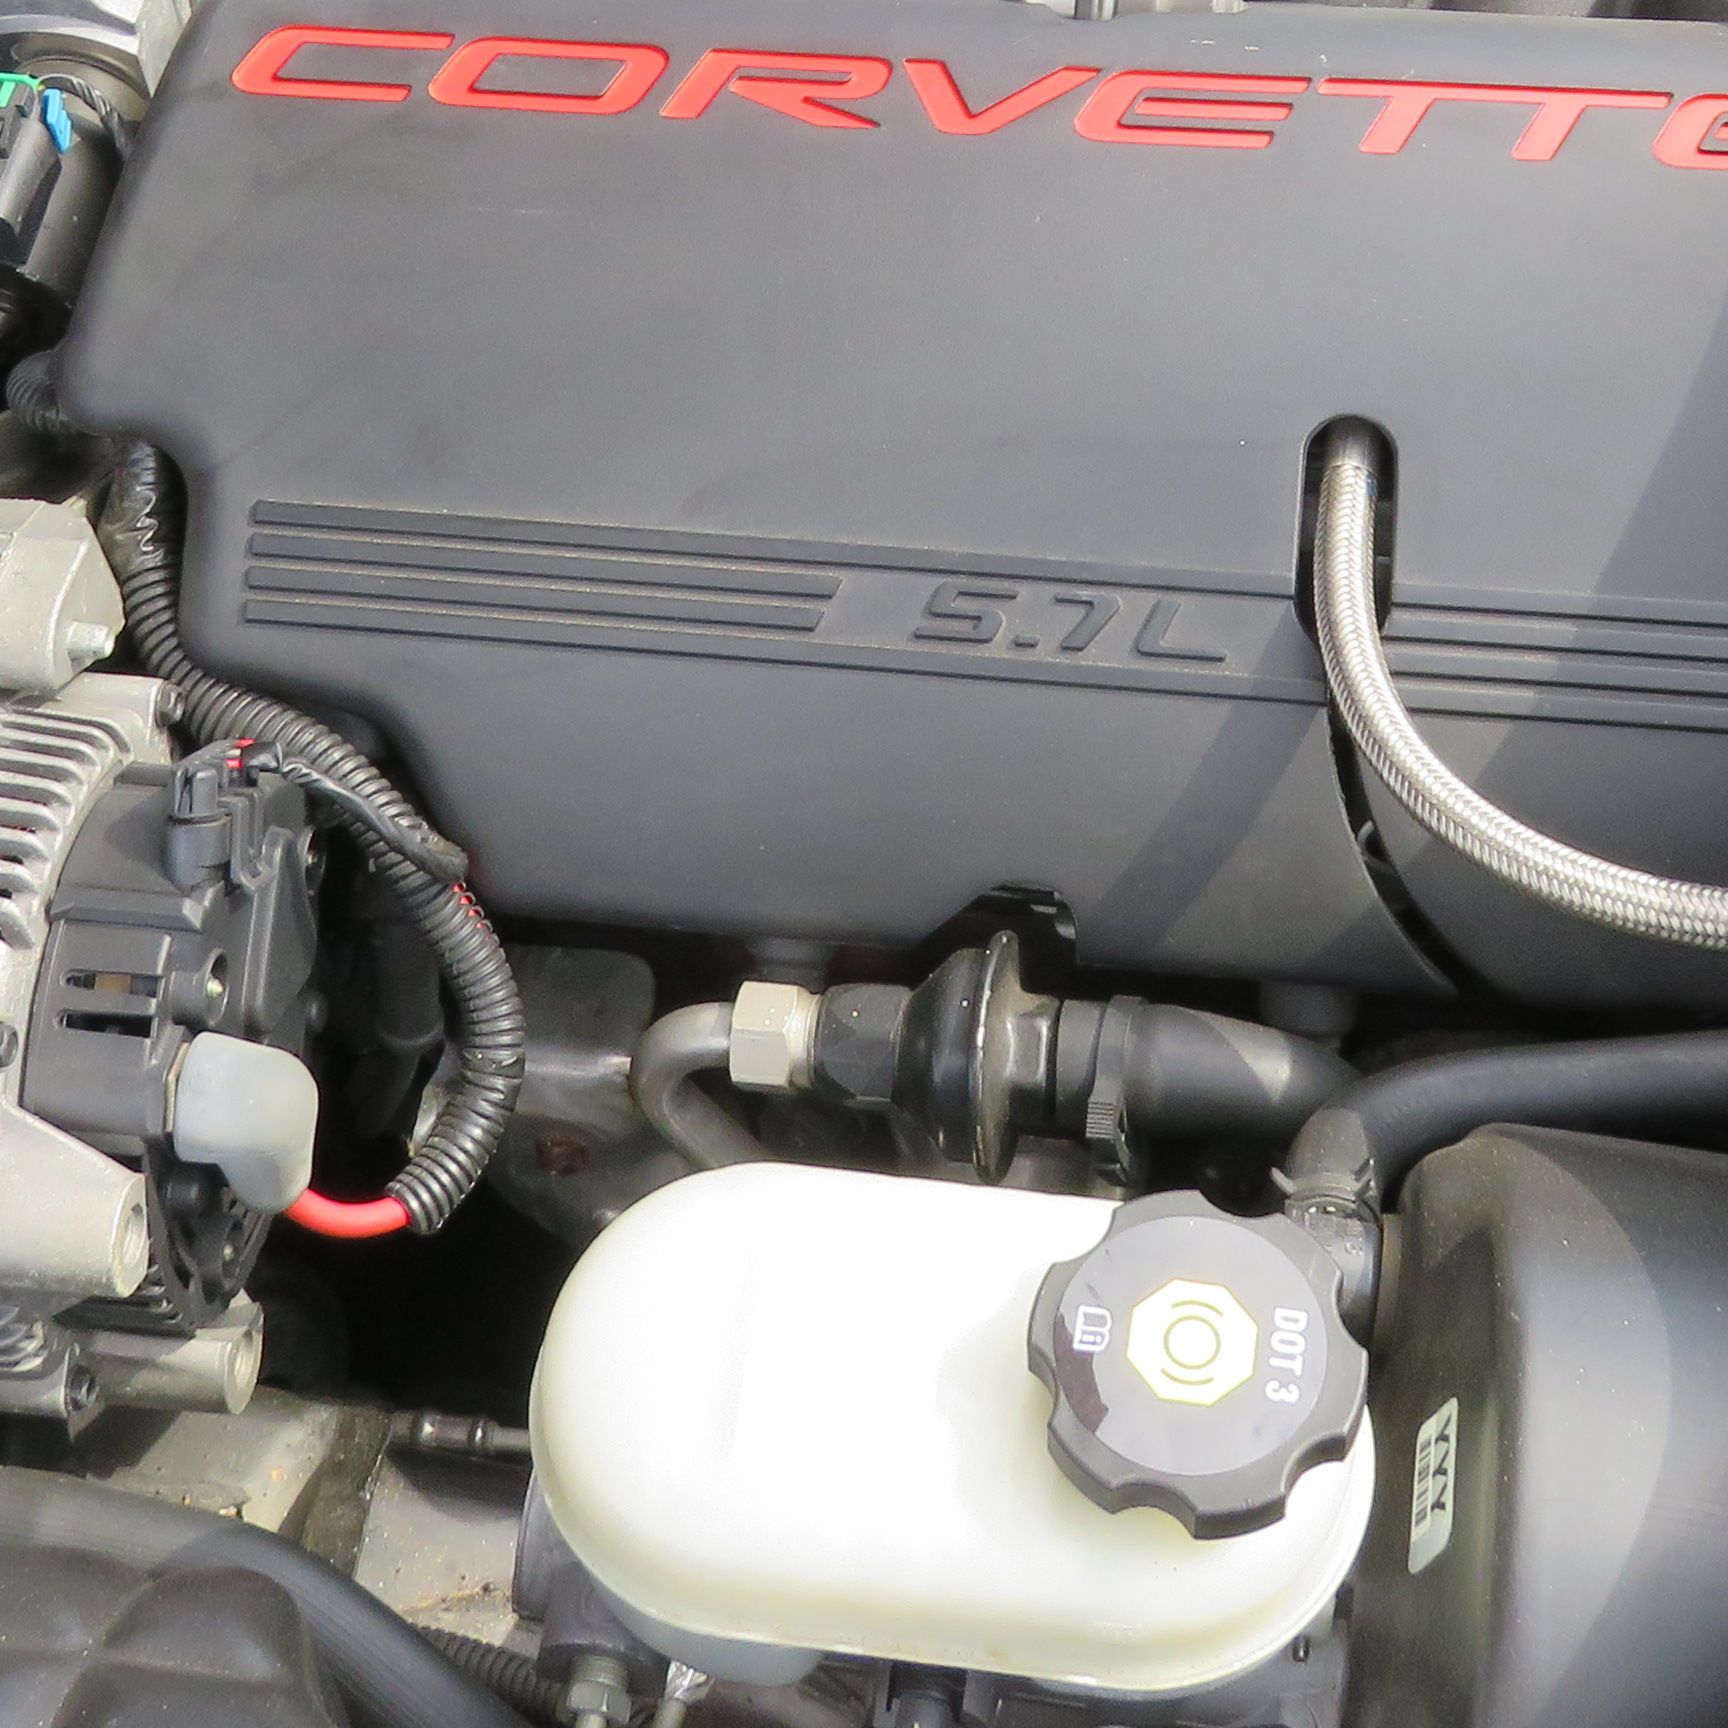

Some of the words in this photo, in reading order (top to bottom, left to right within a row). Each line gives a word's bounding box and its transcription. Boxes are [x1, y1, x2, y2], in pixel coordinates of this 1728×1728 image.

[909, 582, 1233, 664] 5.7L
[1268, 1306, 1309, 1378] DOT
[1264, 1379, 1301, 1405] 3
